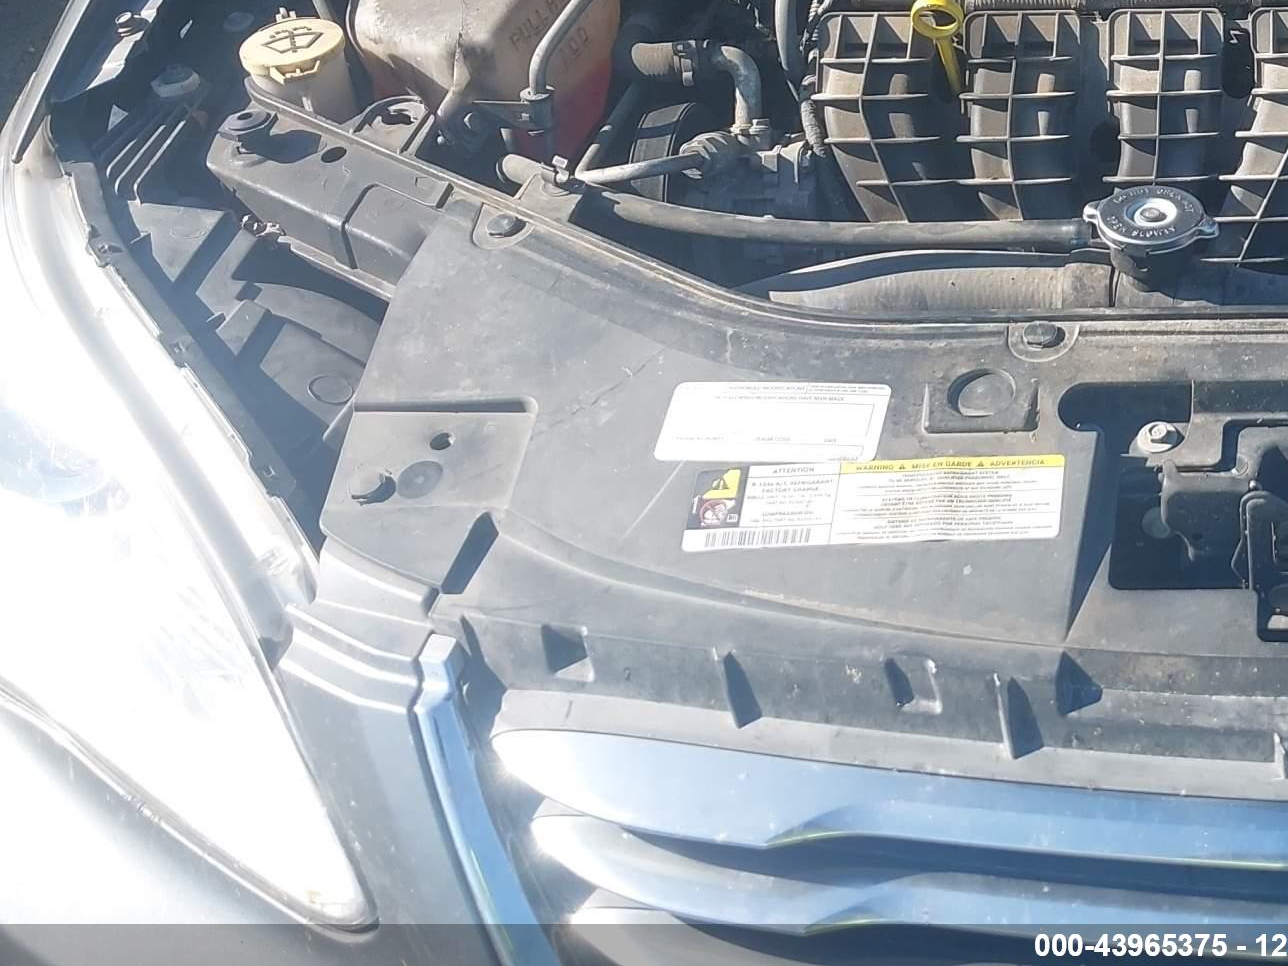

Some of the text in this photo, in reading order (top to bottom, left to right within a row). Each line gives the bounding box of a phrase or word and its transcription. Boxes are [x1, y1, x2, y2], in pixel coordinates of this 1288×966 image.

[772, 466, 815, 474] ATTENTION
[855, 463, 895, 472] WARNING
[944, 460, 972, 468] GARDE
[989, 458, 1046, 467] ADVERTENCIA
